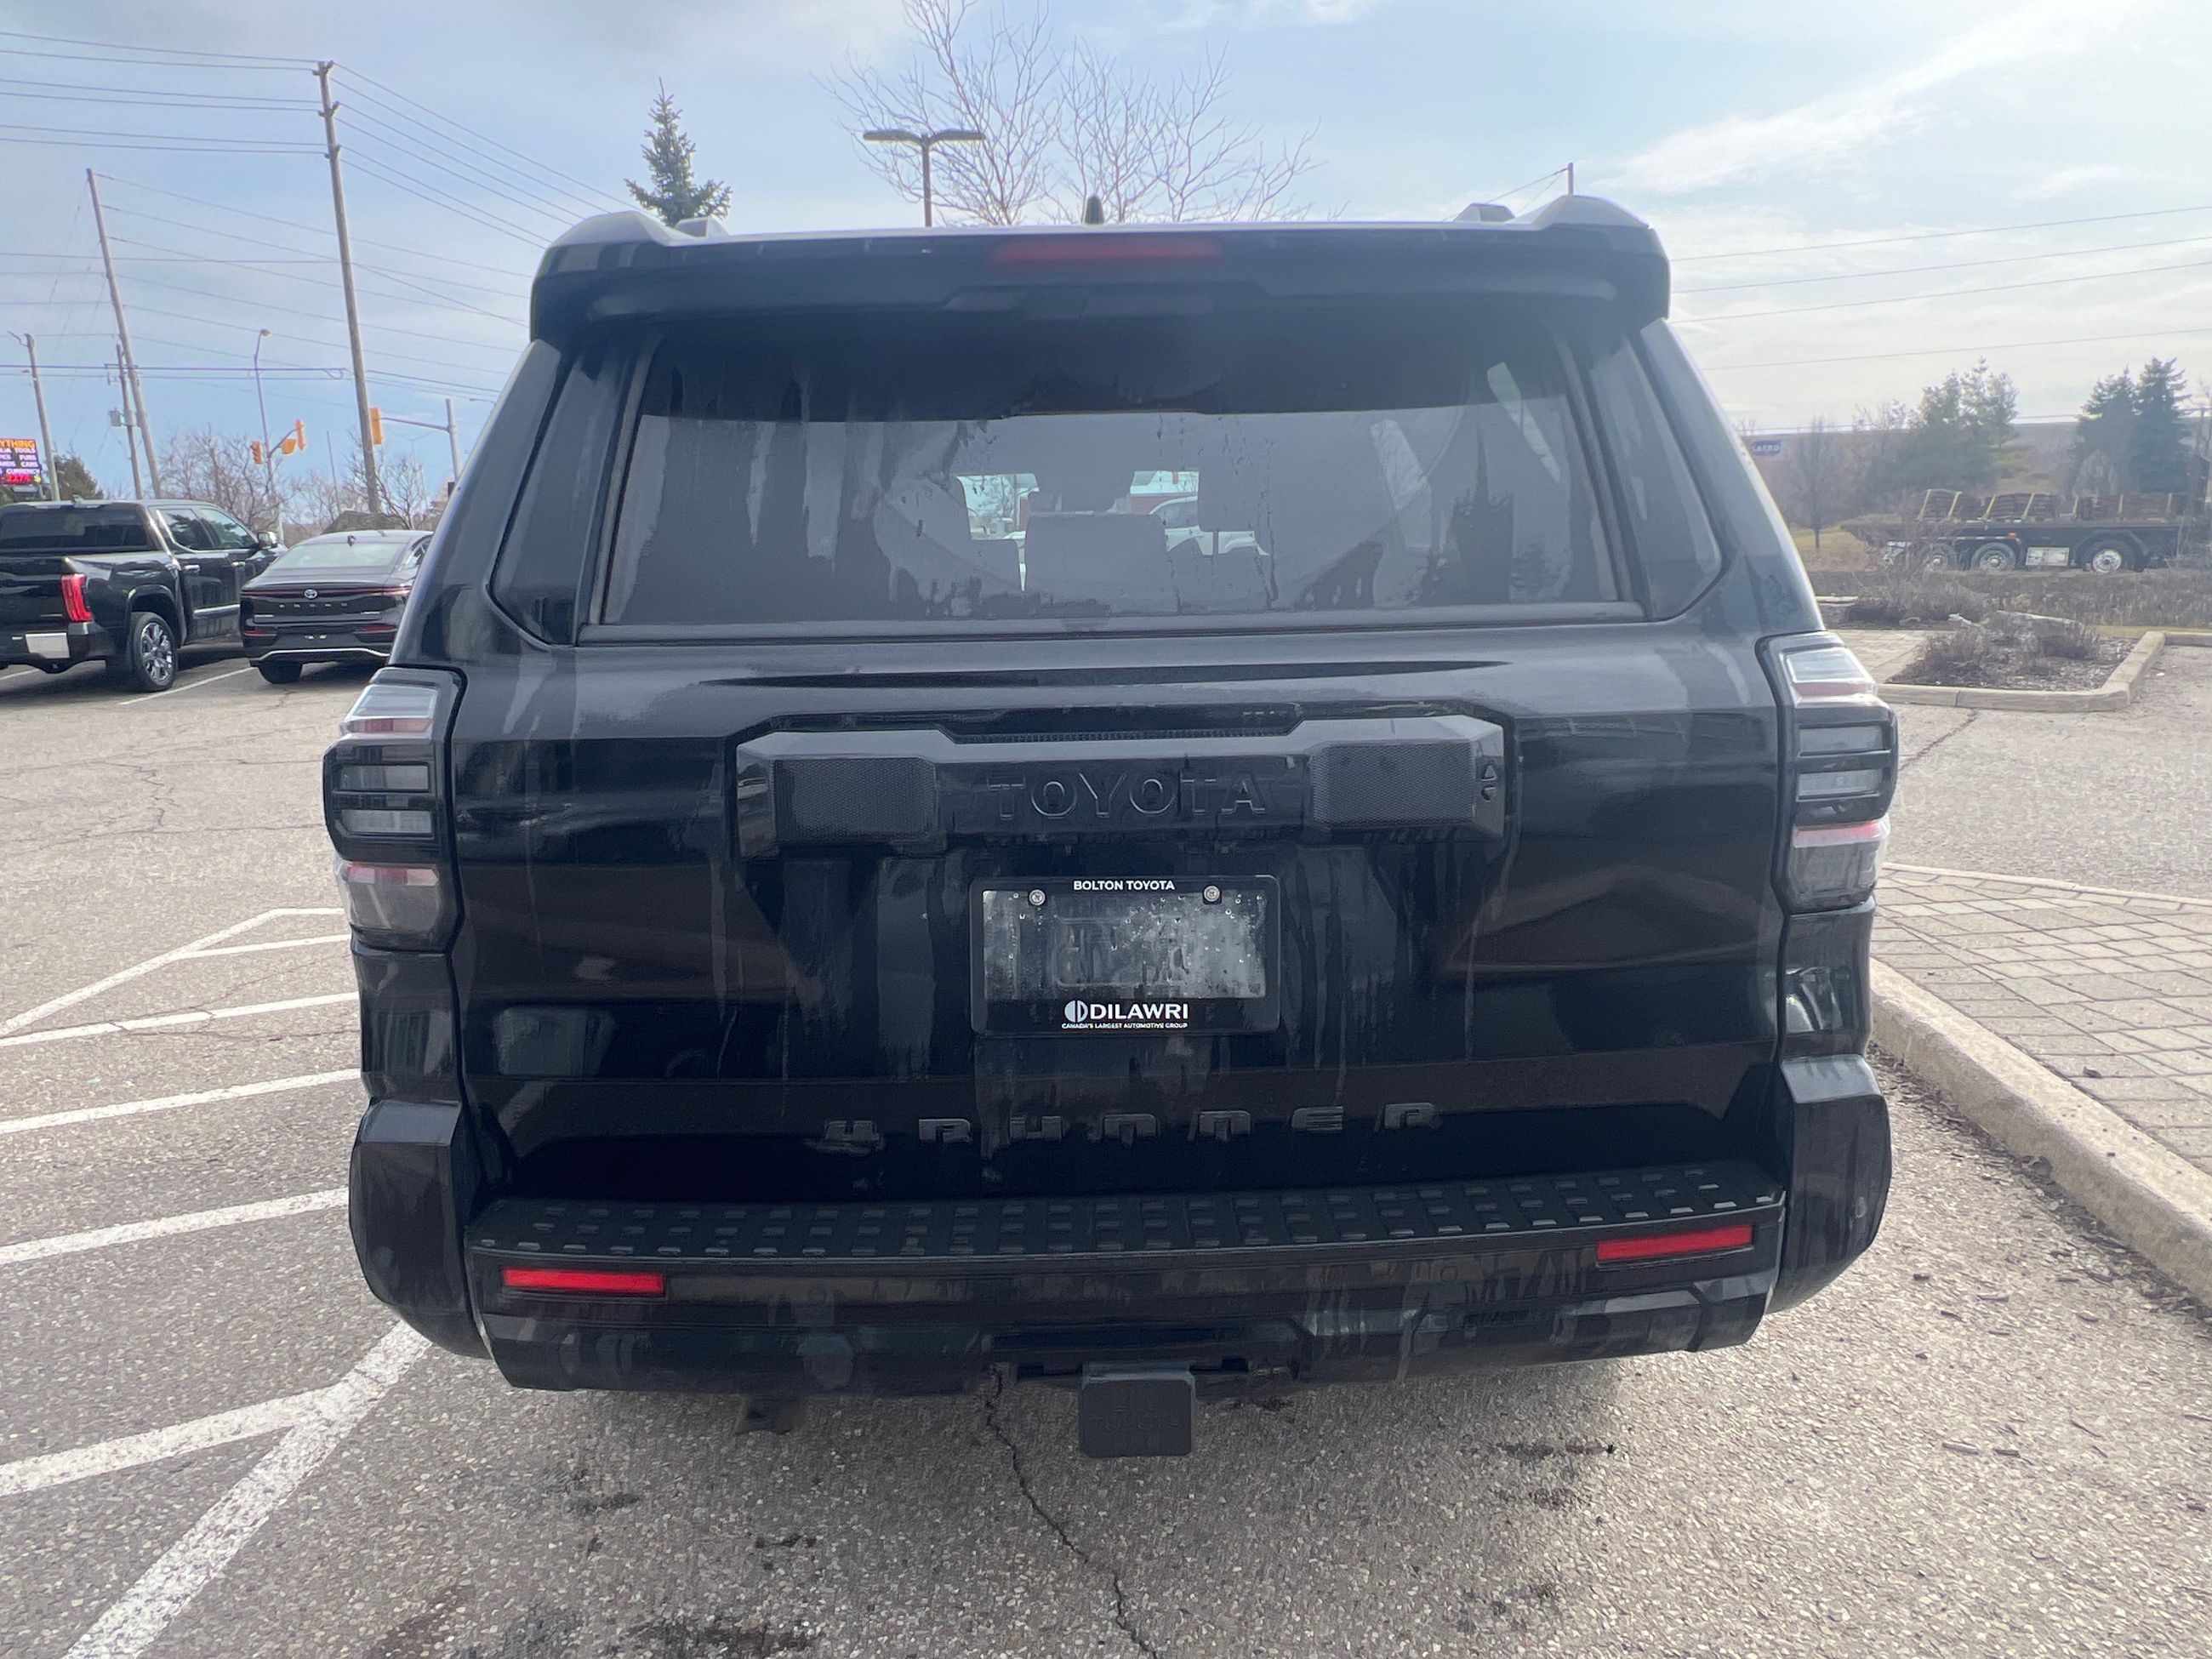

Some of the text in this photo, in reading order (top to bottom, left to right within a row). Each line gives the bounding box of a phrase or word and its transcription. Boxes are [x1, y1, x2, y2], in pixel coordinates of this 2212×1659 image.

[988, 771, 1266, 818] TOYOTA
[1073, 880, 1176, 891] BOLTON TOYOTA
[1090, 1003, 1189, 1020] DILAWRI
